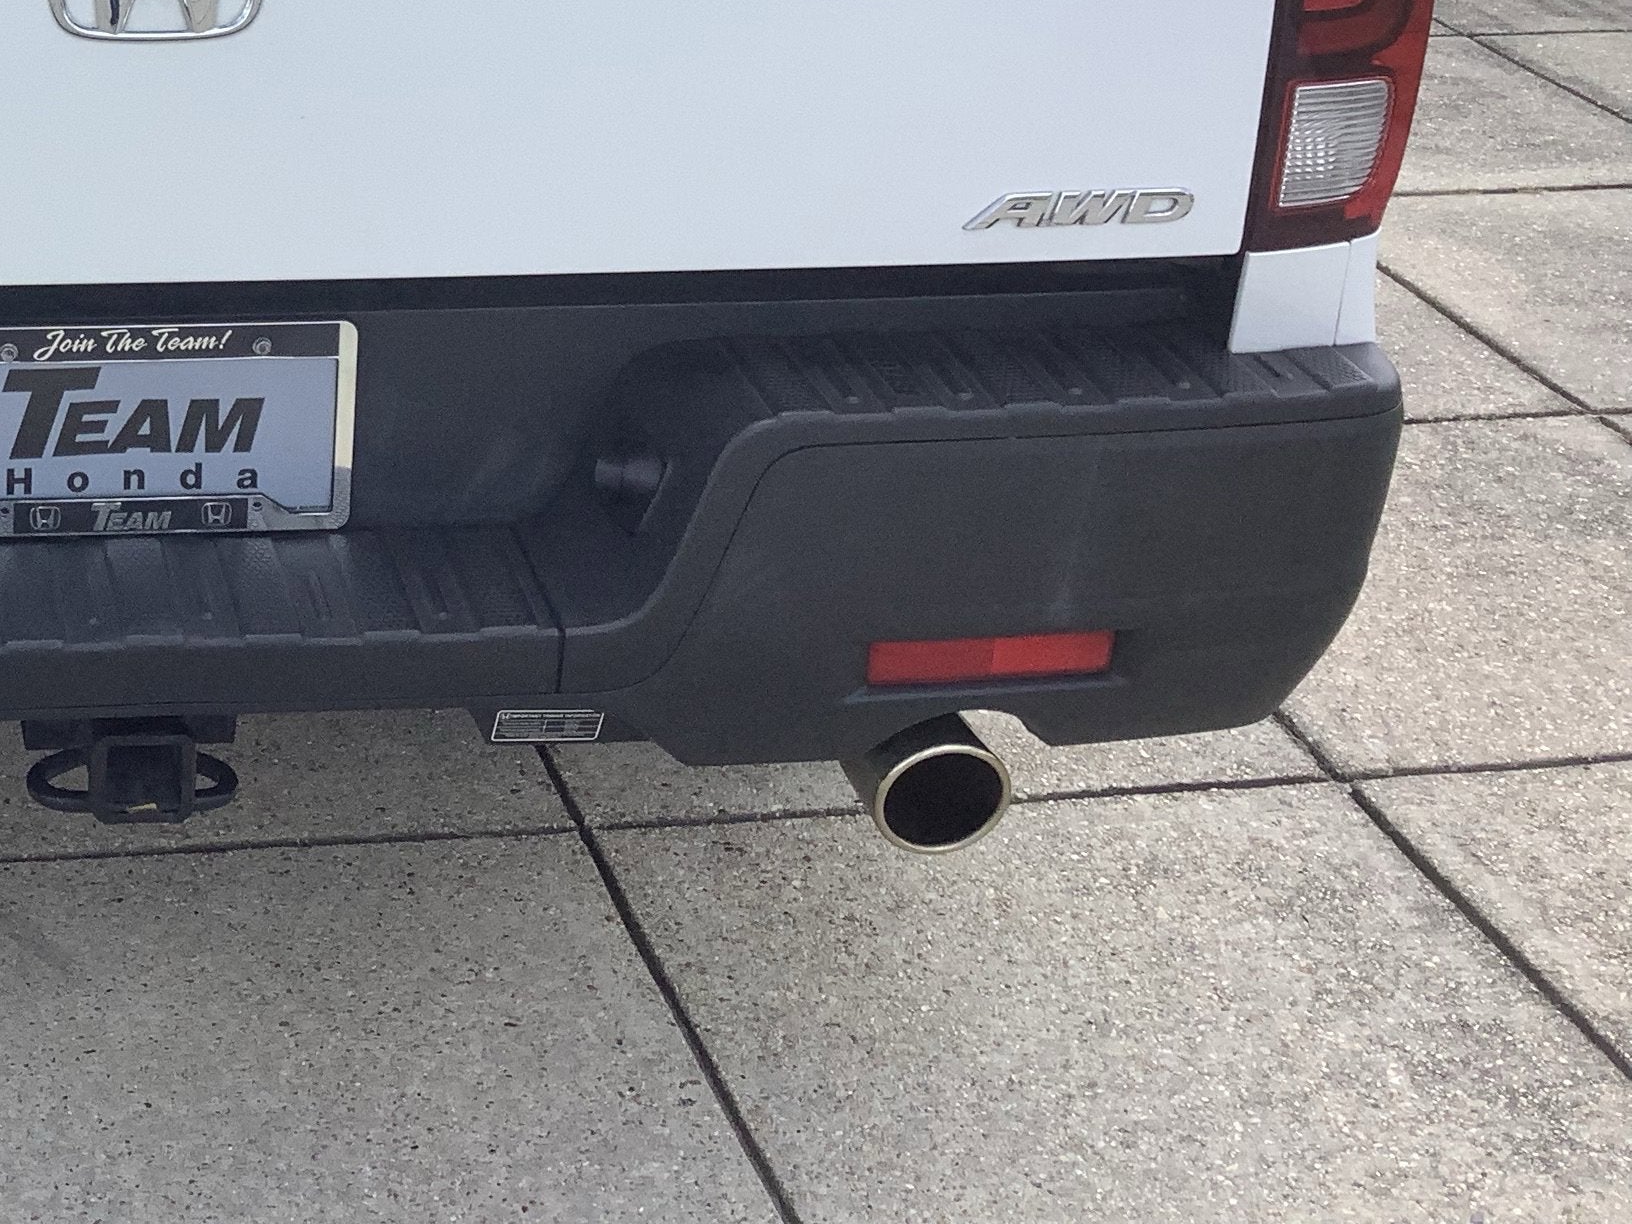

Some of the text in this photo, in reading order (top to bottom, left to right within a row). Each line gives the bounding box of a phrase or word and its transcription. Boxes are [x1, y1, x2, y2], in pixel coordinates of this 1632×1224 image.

[961, 187, 1195, 231] AWD
[33, 328, 232, 361] Join The Team!
[2, 366, 265, 460] TEAM
[6, 462, 259, 496] Honda
[90, 502, 172, 531] TEAM
